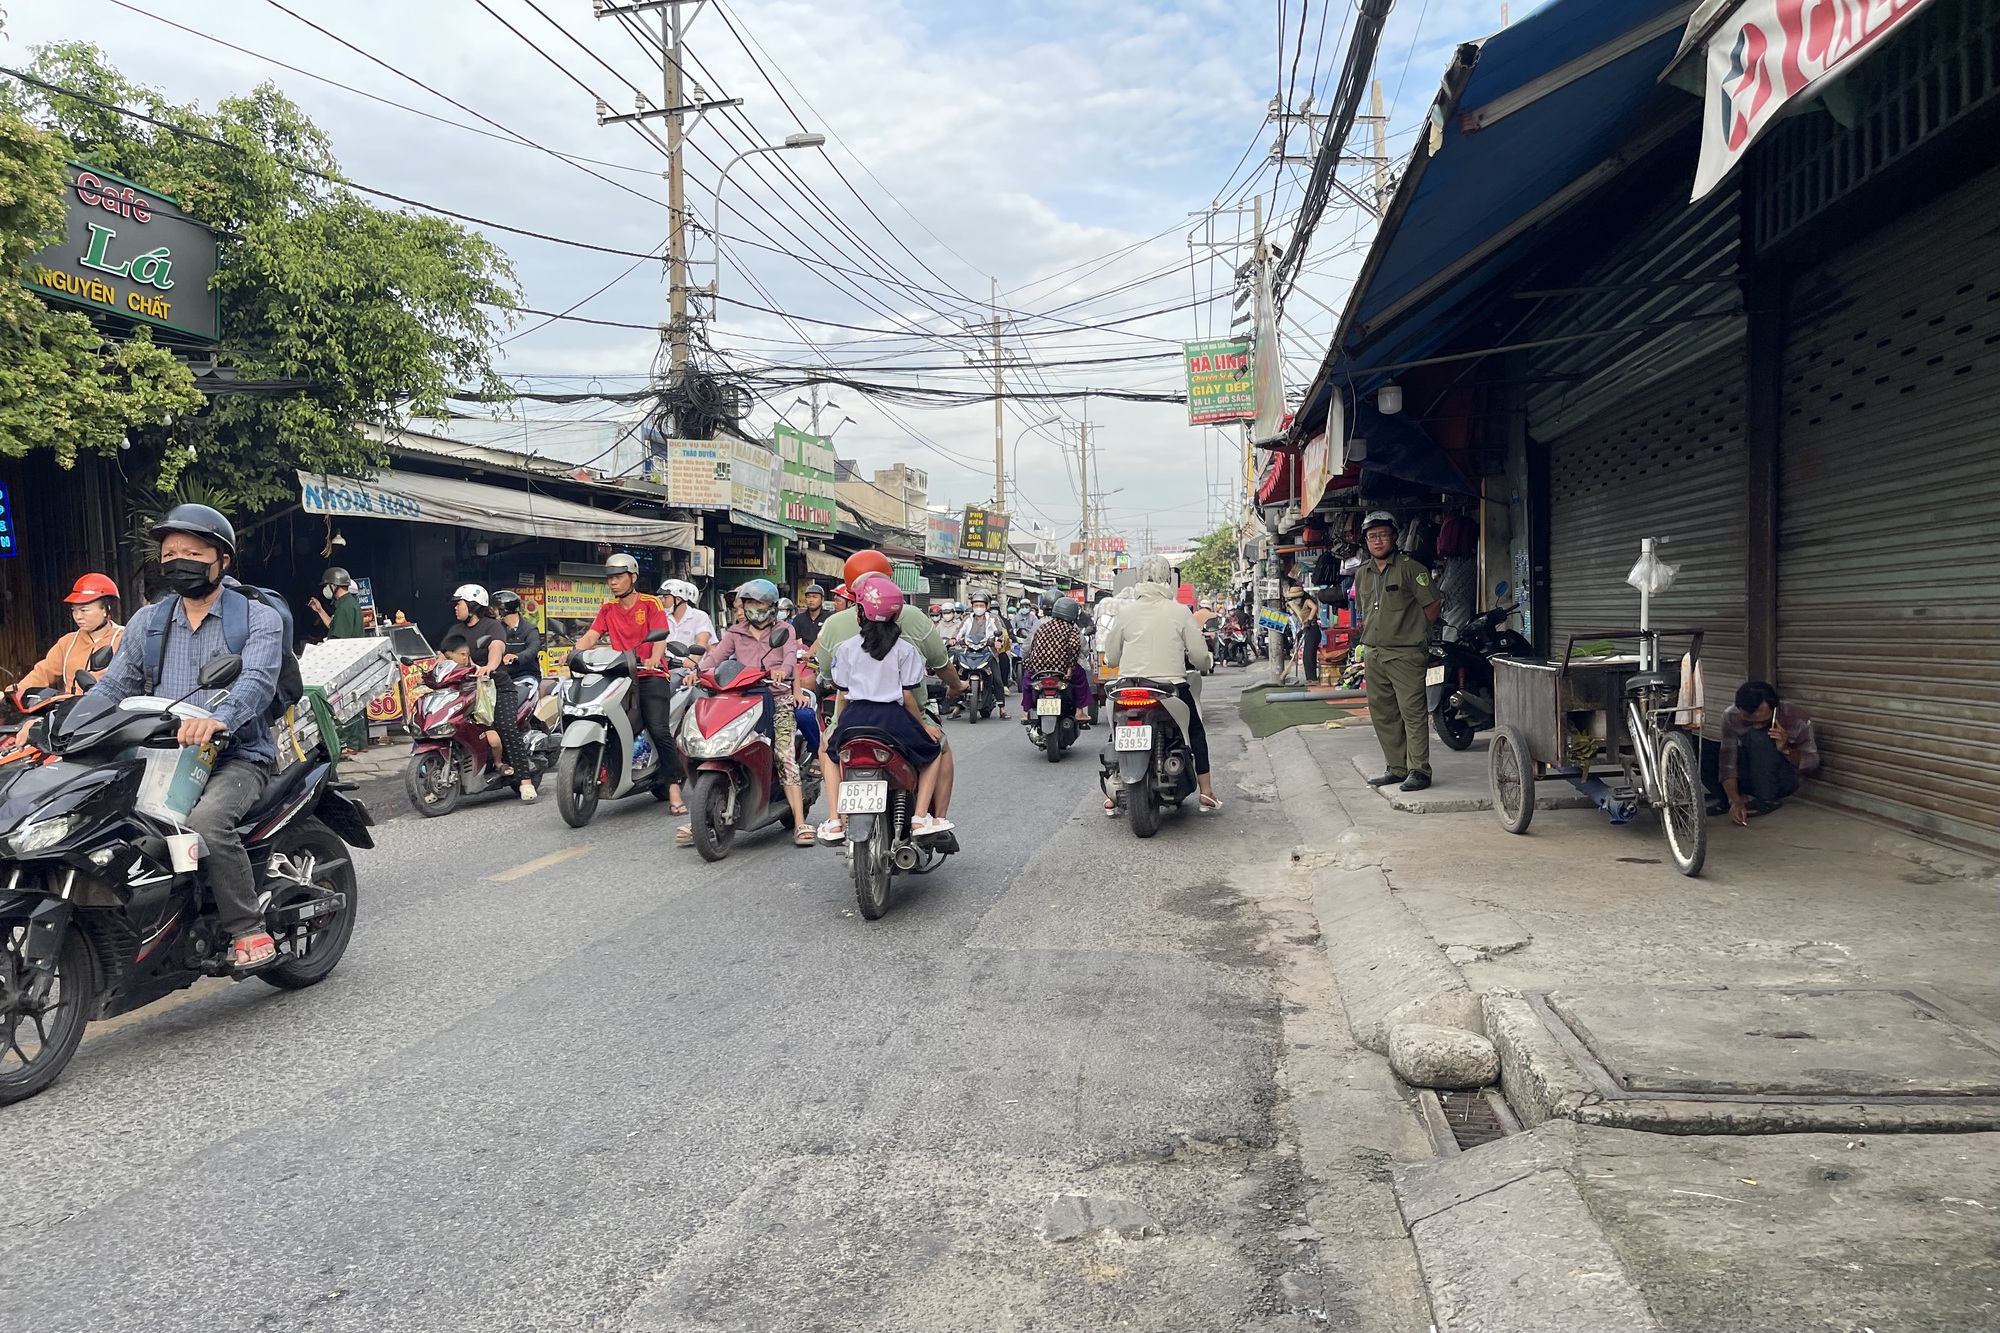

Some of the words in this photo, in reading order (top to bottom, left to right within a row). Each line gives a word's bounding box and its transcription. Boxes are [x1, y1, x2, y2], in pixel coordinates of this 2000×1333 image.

[77, 172, 152, 223] Cafe
[79, 221, 175, 290] Lá
[38, 270, 116, 305] NGUYÊN
[127, 292, 172, 320] CHẤT
[1190, 352, 1213, 373] HÀ
[1192, 383, 1221, 396] GIÀY
[1225, 381, 1250, 393] DÉP
[1231, 394, 1251, 402] SÁCH
[669, 441, 687, 449] DỊCH
[1121, 728, 1146, 738] 50-AA
[1118, 738, 1149, 749] 639.52
[846, 783, 879, 797] 66-P1
[840, 797, 884, 811] 894.28
